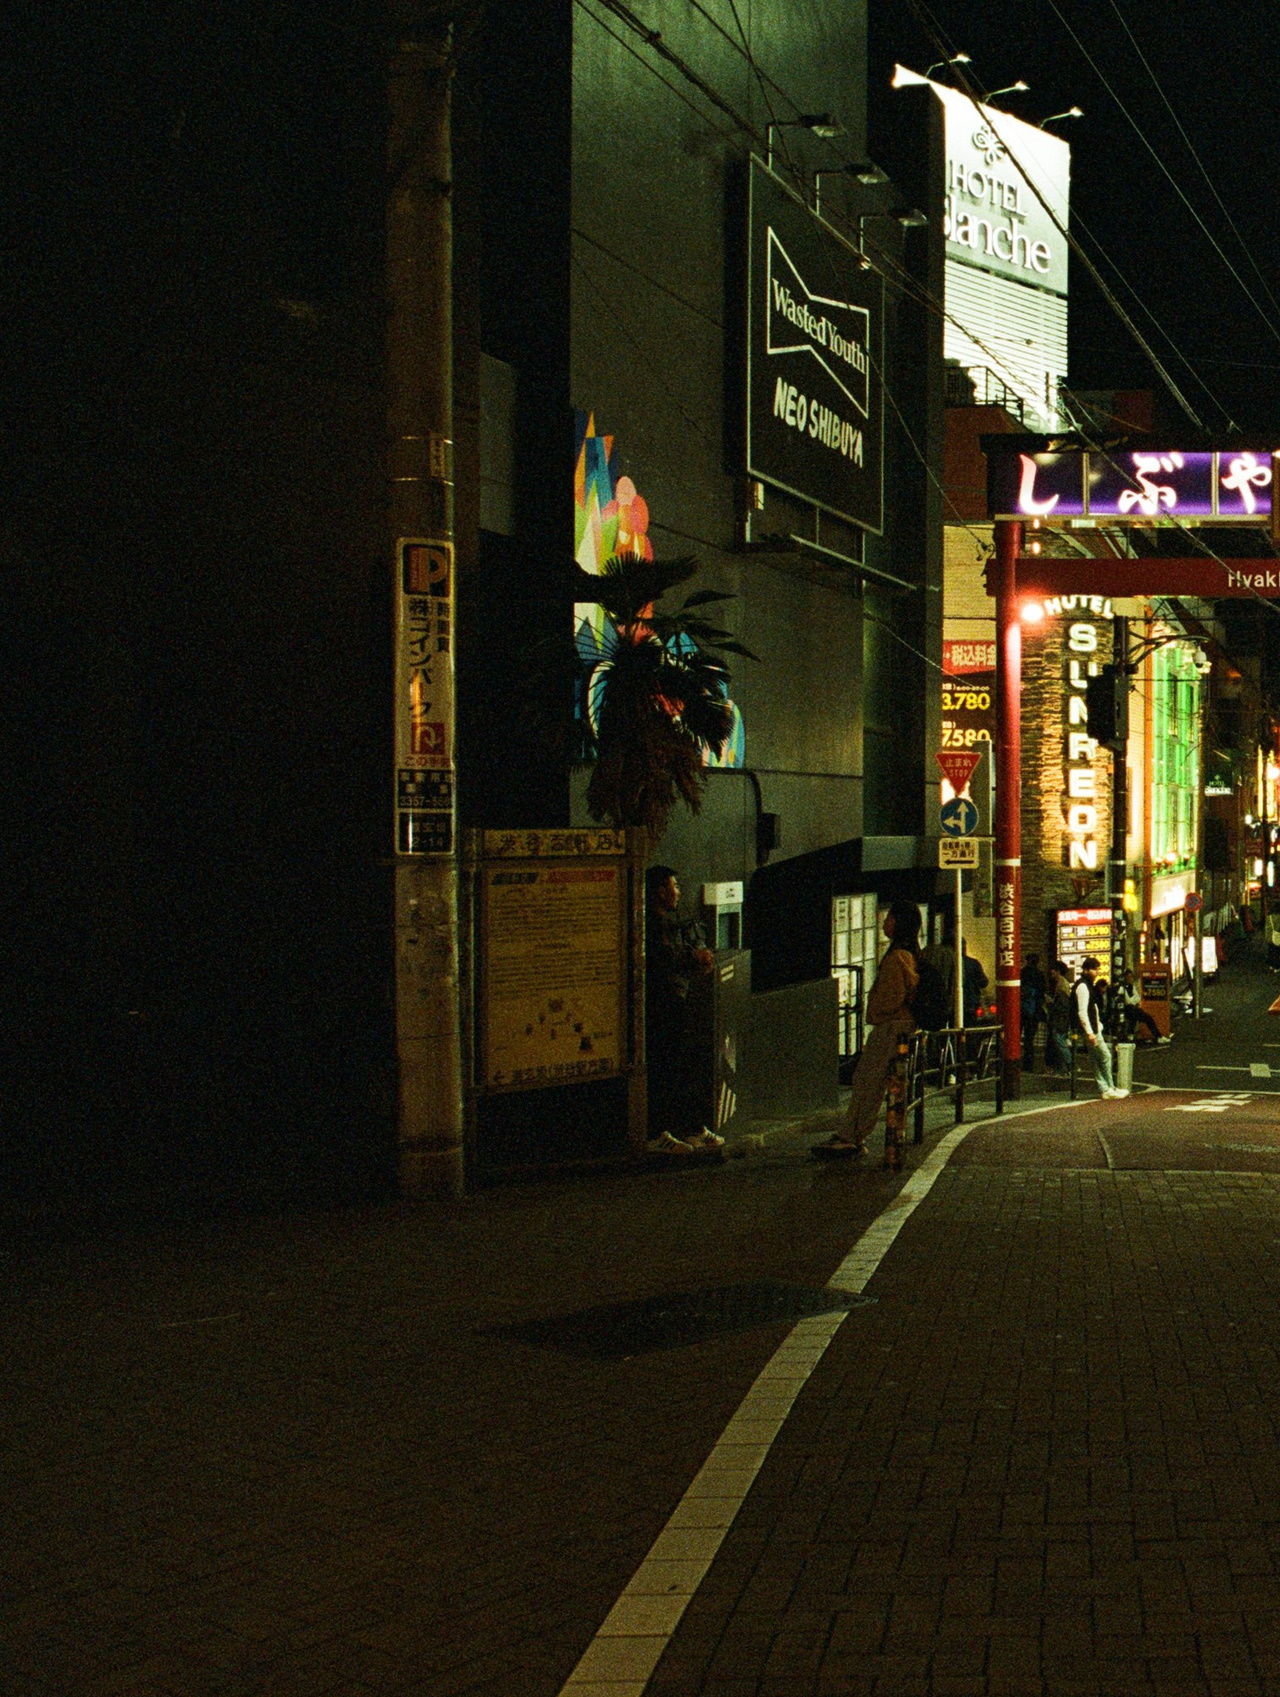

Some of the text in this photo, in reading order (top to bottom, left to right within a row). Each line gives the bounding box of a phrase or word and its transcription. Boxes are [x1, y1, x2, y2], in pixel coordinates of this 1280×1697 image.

[949, 160, 1028, 217] HOTEL
[772, 278, 866, 375] Wasted Youth
[773, 376, 863, 469] NEO SHIBUYA
[944, 758, 973, 768] 止まれ
[948, 769, 969, 778] STOP
[999, 883, 1015, 966] 渋谷百軒店
